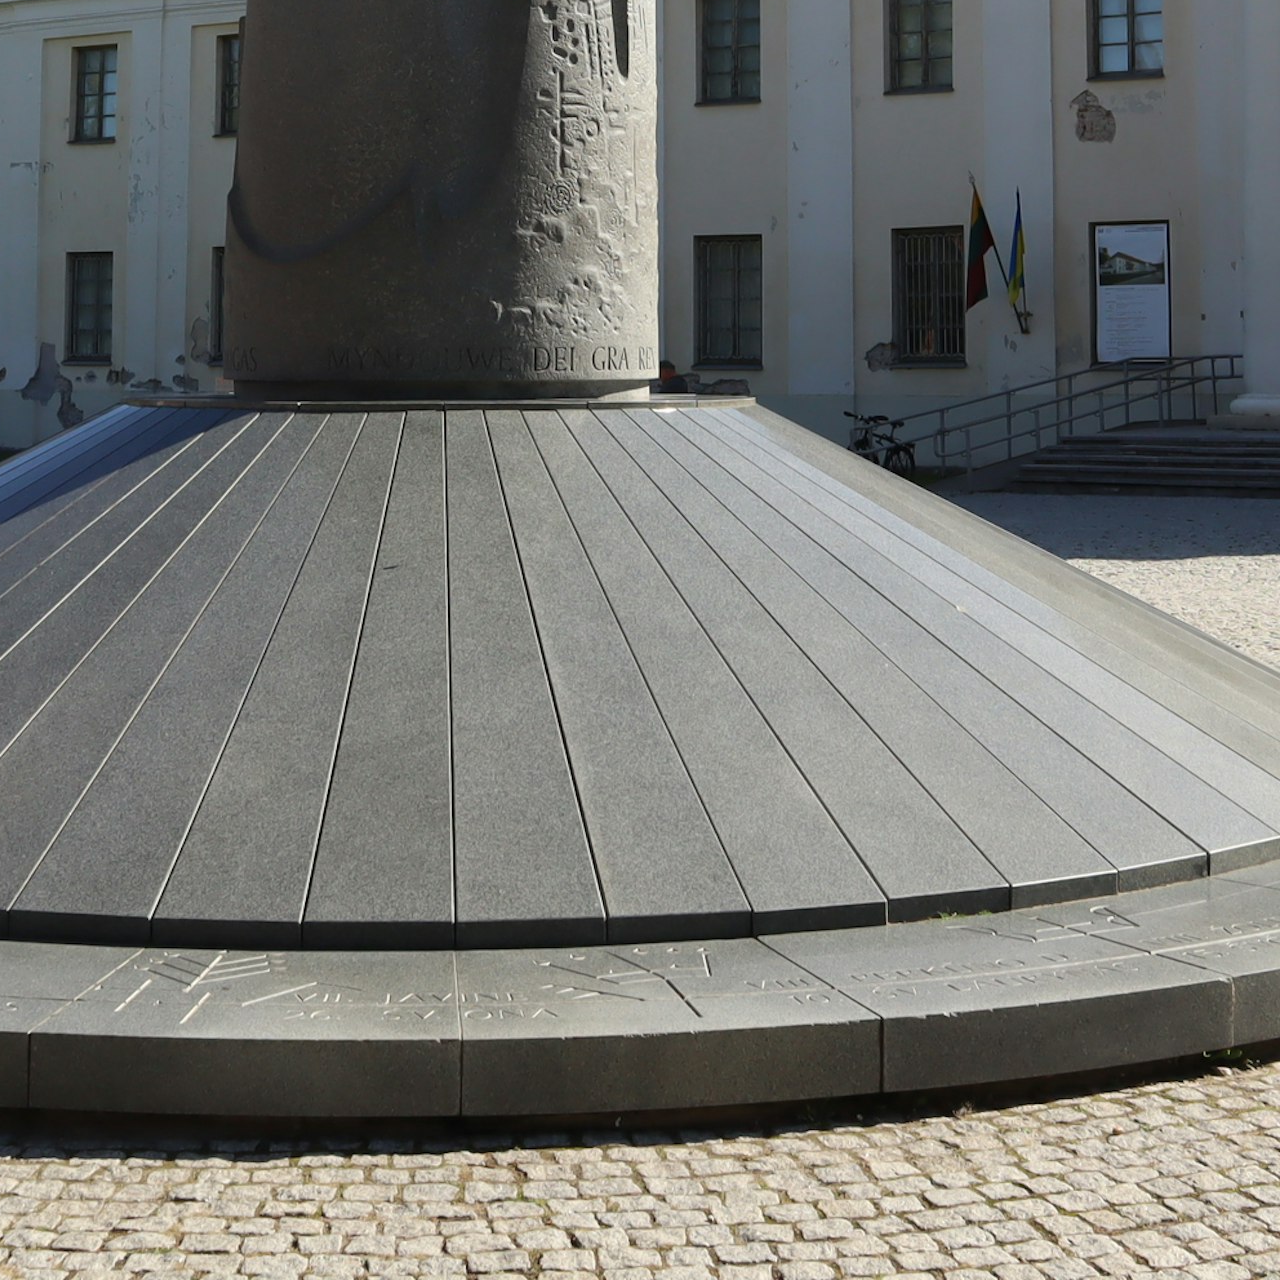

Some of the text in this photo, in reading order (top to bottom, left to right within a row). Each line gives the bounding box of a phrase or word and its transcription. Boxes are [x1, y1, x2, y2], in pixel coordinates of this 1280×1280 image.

[533, 346, 575, 372] DEI
[591, 345, 630, 372] GRA
[463, 1007, 559, 1021] ONA
